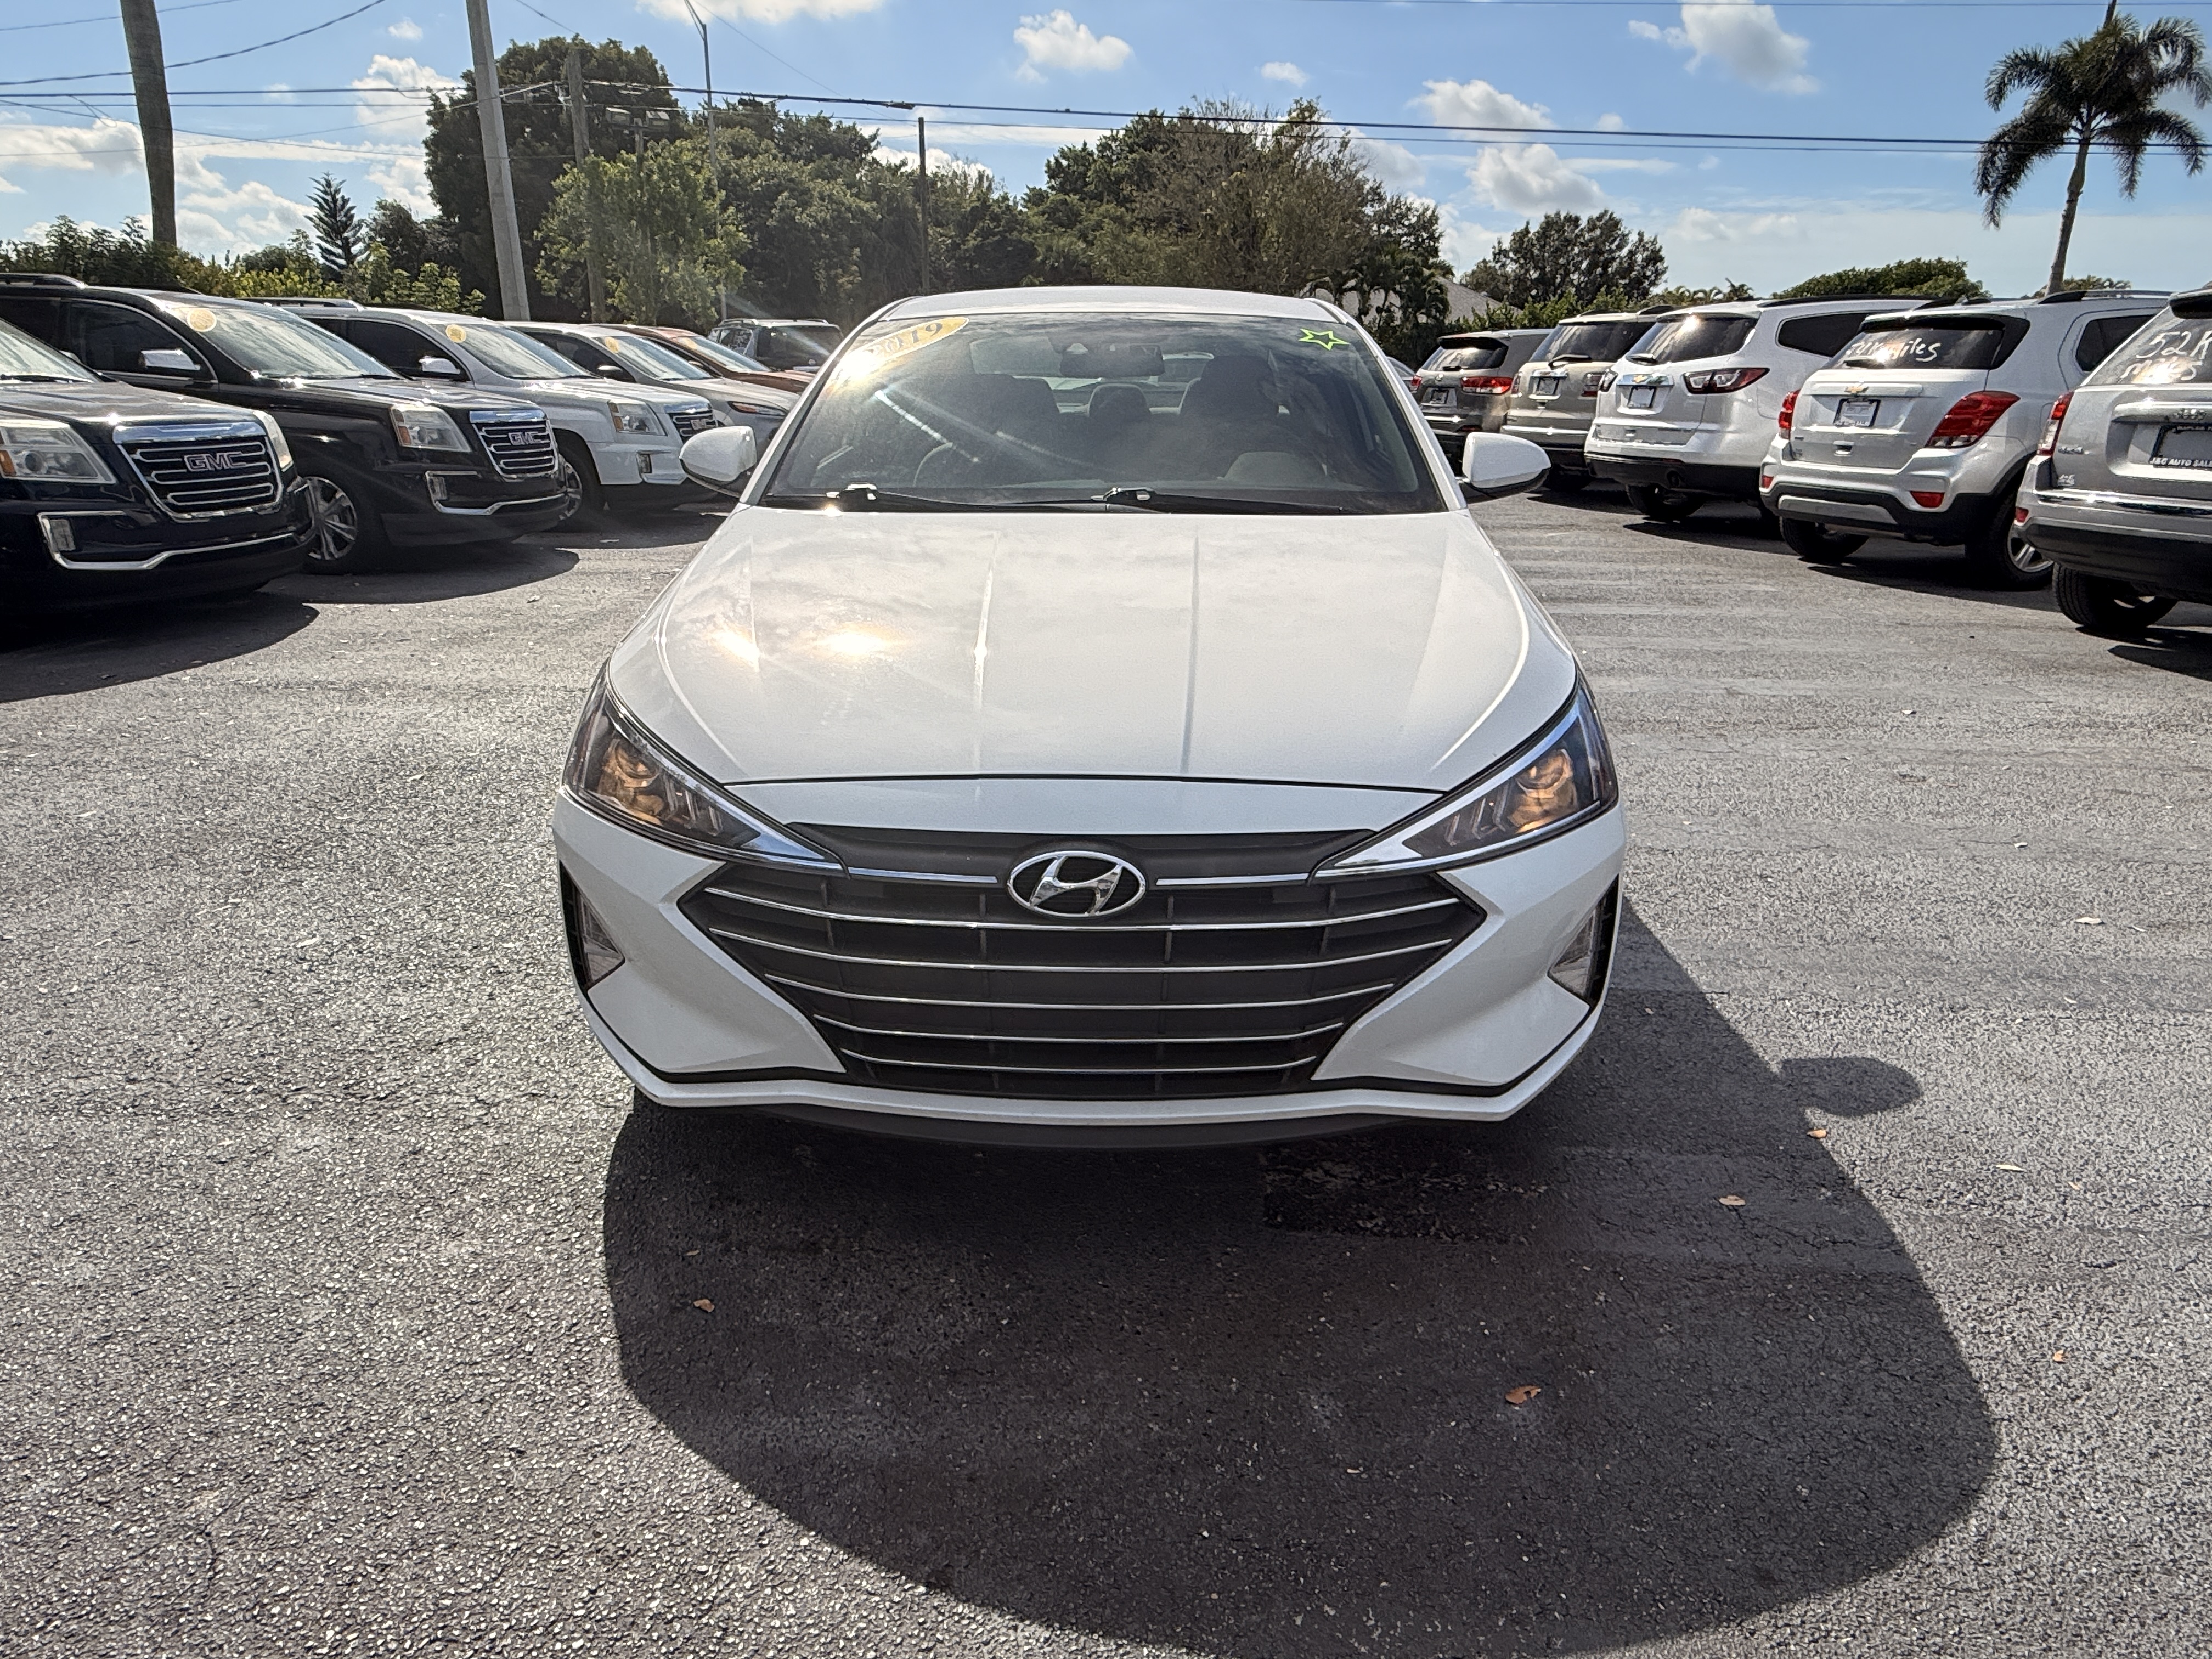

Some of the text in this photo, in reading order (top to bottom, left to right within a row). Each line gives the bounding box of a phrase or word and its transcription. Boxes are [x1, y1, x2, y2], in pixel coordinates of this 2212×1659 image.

[2120, 356, 2203, 381] mles
[508, 431, 541, 445] GMC
[184, 451, 246, 472] GMC
